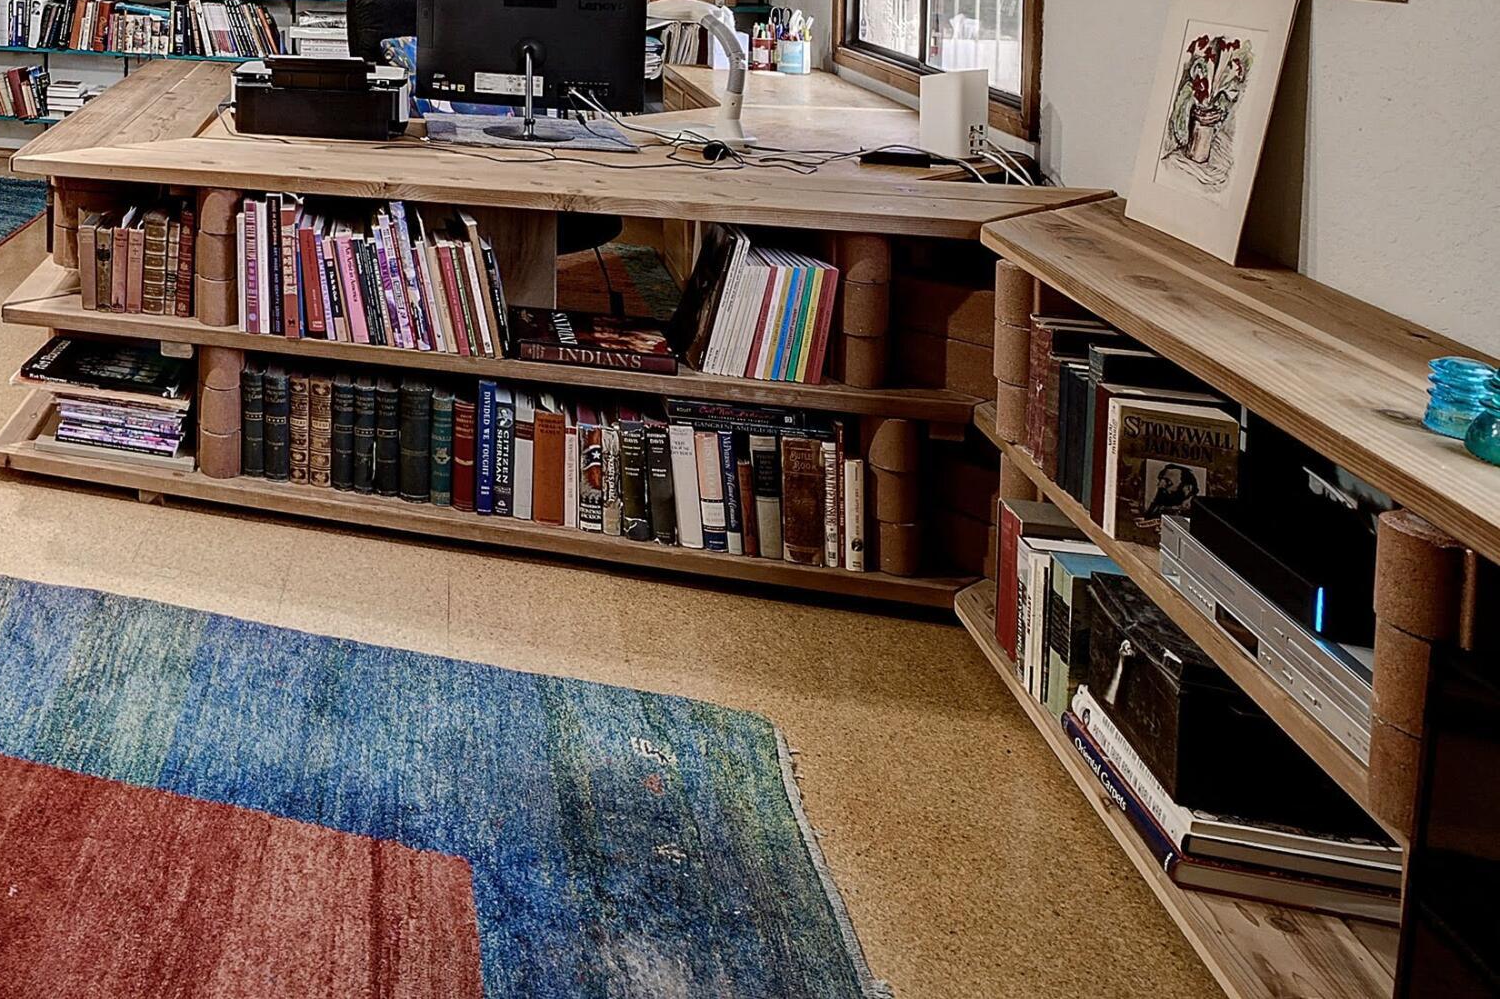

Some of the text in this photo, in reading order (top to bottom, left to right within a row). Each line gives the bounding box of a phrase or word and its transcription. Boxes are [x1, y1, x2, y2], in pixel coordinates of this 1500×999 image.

[578, 0, 627, 12] Lenovo
[558, 347, 642, 369] INDIANS
[481, 391, 491, 477] DIVIDED WE FOUGHT
[1124, 415, 1234, 452] STONEWALL
[1145, 436, 1213, 463] JACKSON
[495, 429, 503, 485] SHERMAN
[502, 429, 510, 485] CITIZEN
[792, 461, 816, 472] BOOK
[580, 512, 601, 520] JACKSON
[1075, 737, 1127, 811] Oriental Carpets
